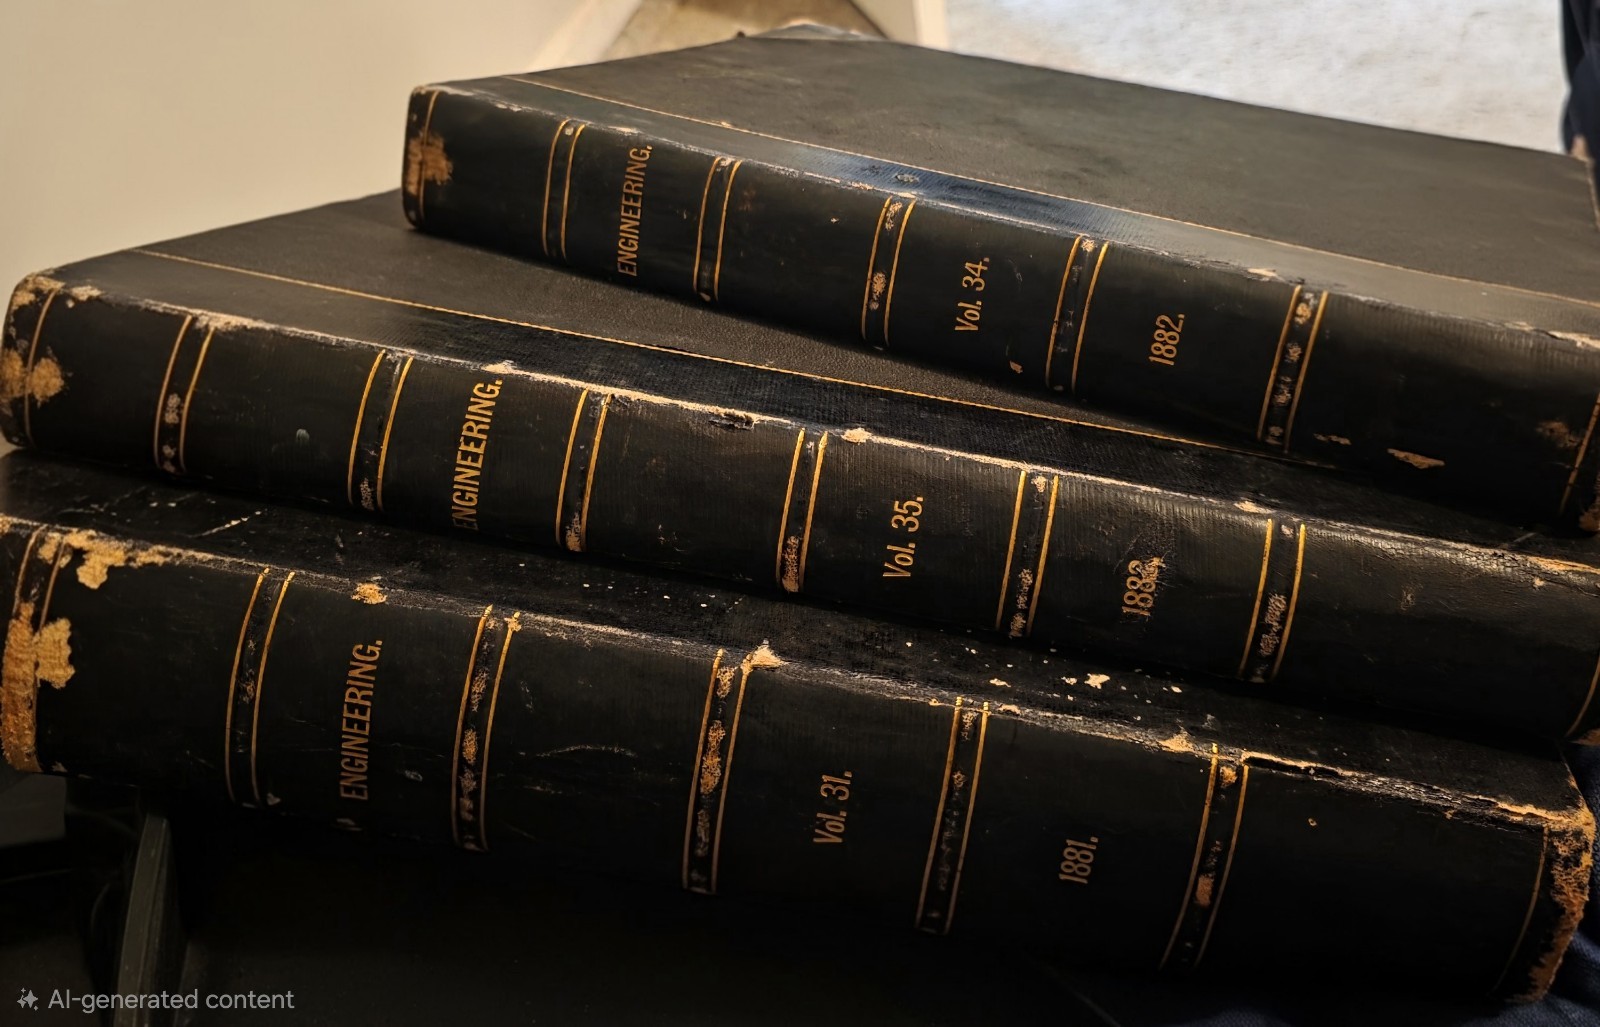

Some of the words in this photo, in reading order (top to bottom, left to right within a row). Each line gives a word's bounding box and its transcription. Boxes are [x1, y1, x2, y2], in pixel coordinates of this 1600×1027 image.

[617, 145, 653, 277] ENGINEERING.
[962, 257, 990, 291] 34.
[954, 300, 982, 331] Vol.
[1148, 313, 1185, 366] 1882.
[451, 379, 503, 531] ENGINEERING.
[891, 496, 924, 533] 35.
[882, 542, 916, 577] Vol.
[339, 640, 383, 801] ENGINEERING.
[820, 770, 853, 801] 31.
[813, 810, 847, 843] Vol.
[1058, 836, 1099, 885] 1881.
